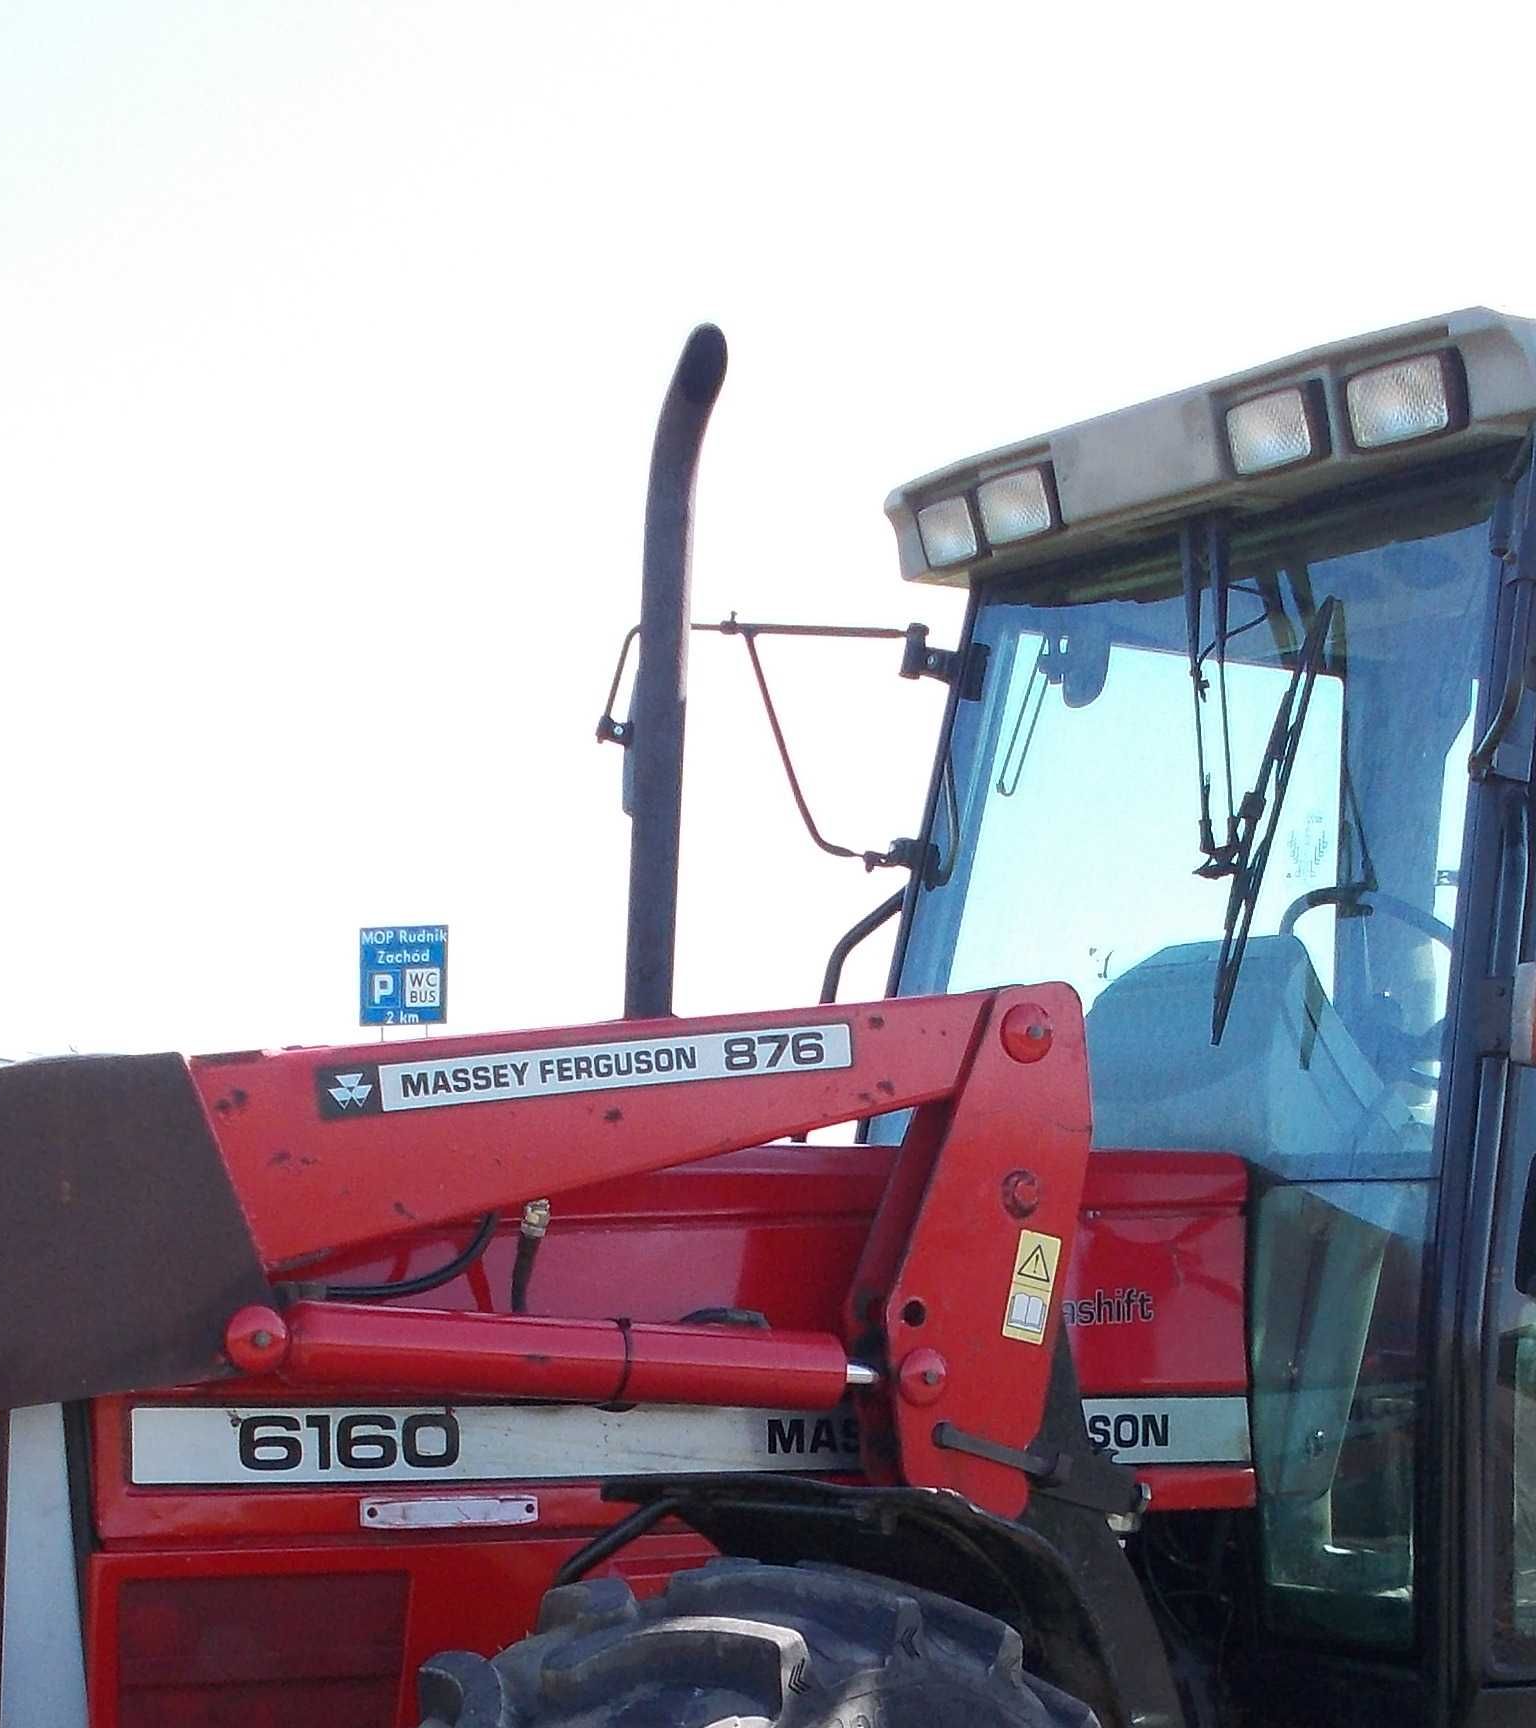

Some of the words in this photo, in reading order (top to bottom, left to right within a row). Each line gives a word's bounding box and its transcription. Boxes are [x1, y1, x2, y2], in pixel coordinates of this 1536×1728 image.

[361, 930, 394, 945] MOP
[399, 928, 449, 943] Rudnik
[376, 949, 430, 964] Zachód
[373, 973, 394, 1005] P
[409, 972, 438, 988] WC
[410, 990, 436, 1003] BUS
[386, 1010, 395, 1024] 2
[399, 1010, 419, 1024] km
[401, 1061, 530, 1098] MASSEY
[539, 1045, 698, 1084] FERGUSON
[723, 1031, 825, 1072] 876
[1063, 1287, 1154, 1327] ashift
[238, 1413, 461, 1472] 6160
[766, 1417, 862, 1456] MAS
[1087, 1413, 1170, 1449] SON
